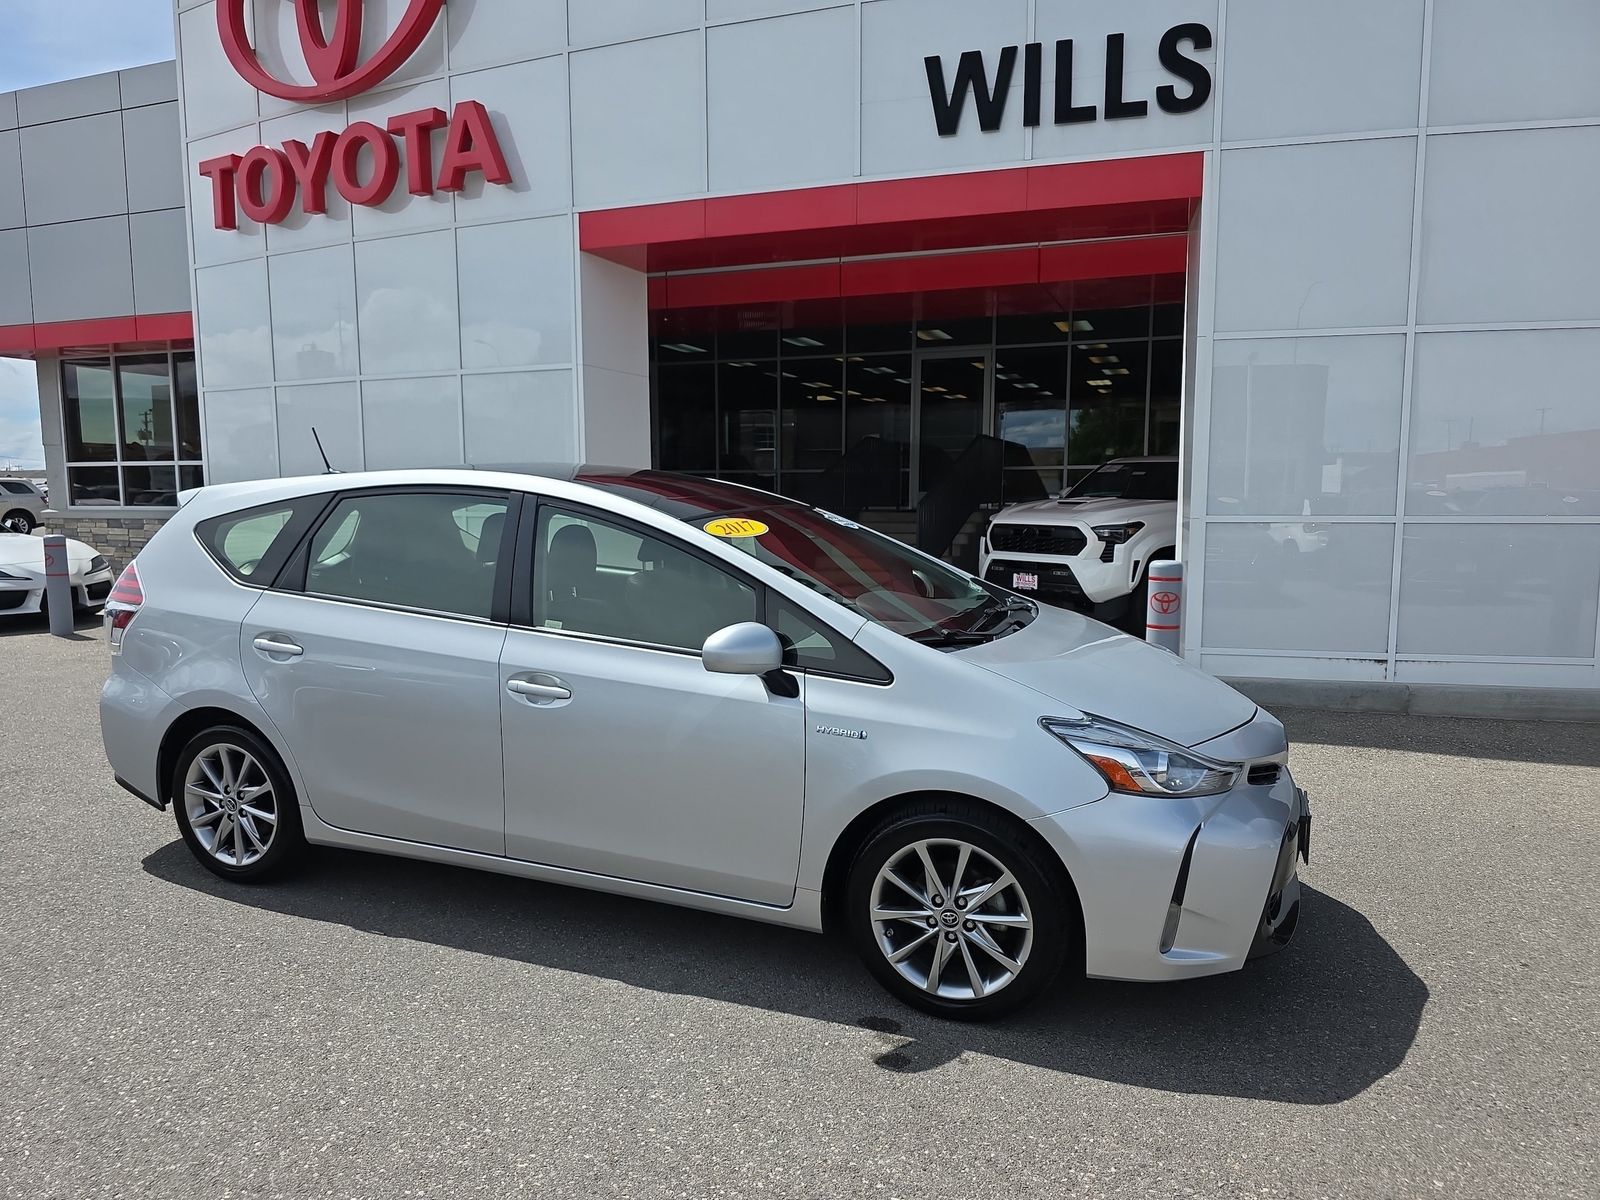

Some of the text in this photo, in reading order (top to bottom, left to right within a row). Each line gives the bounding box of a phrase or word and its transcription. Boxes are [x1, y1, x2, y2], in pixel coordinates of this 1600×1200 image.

[924, 22, 1212, 136] WILLS
[199, 100, 512, 230] TOYOTA
[715, 520, 755, 535] 2017
[1016, 575, 1036, 583] WILLS
[816, 725, 859, 738] HYBRID
